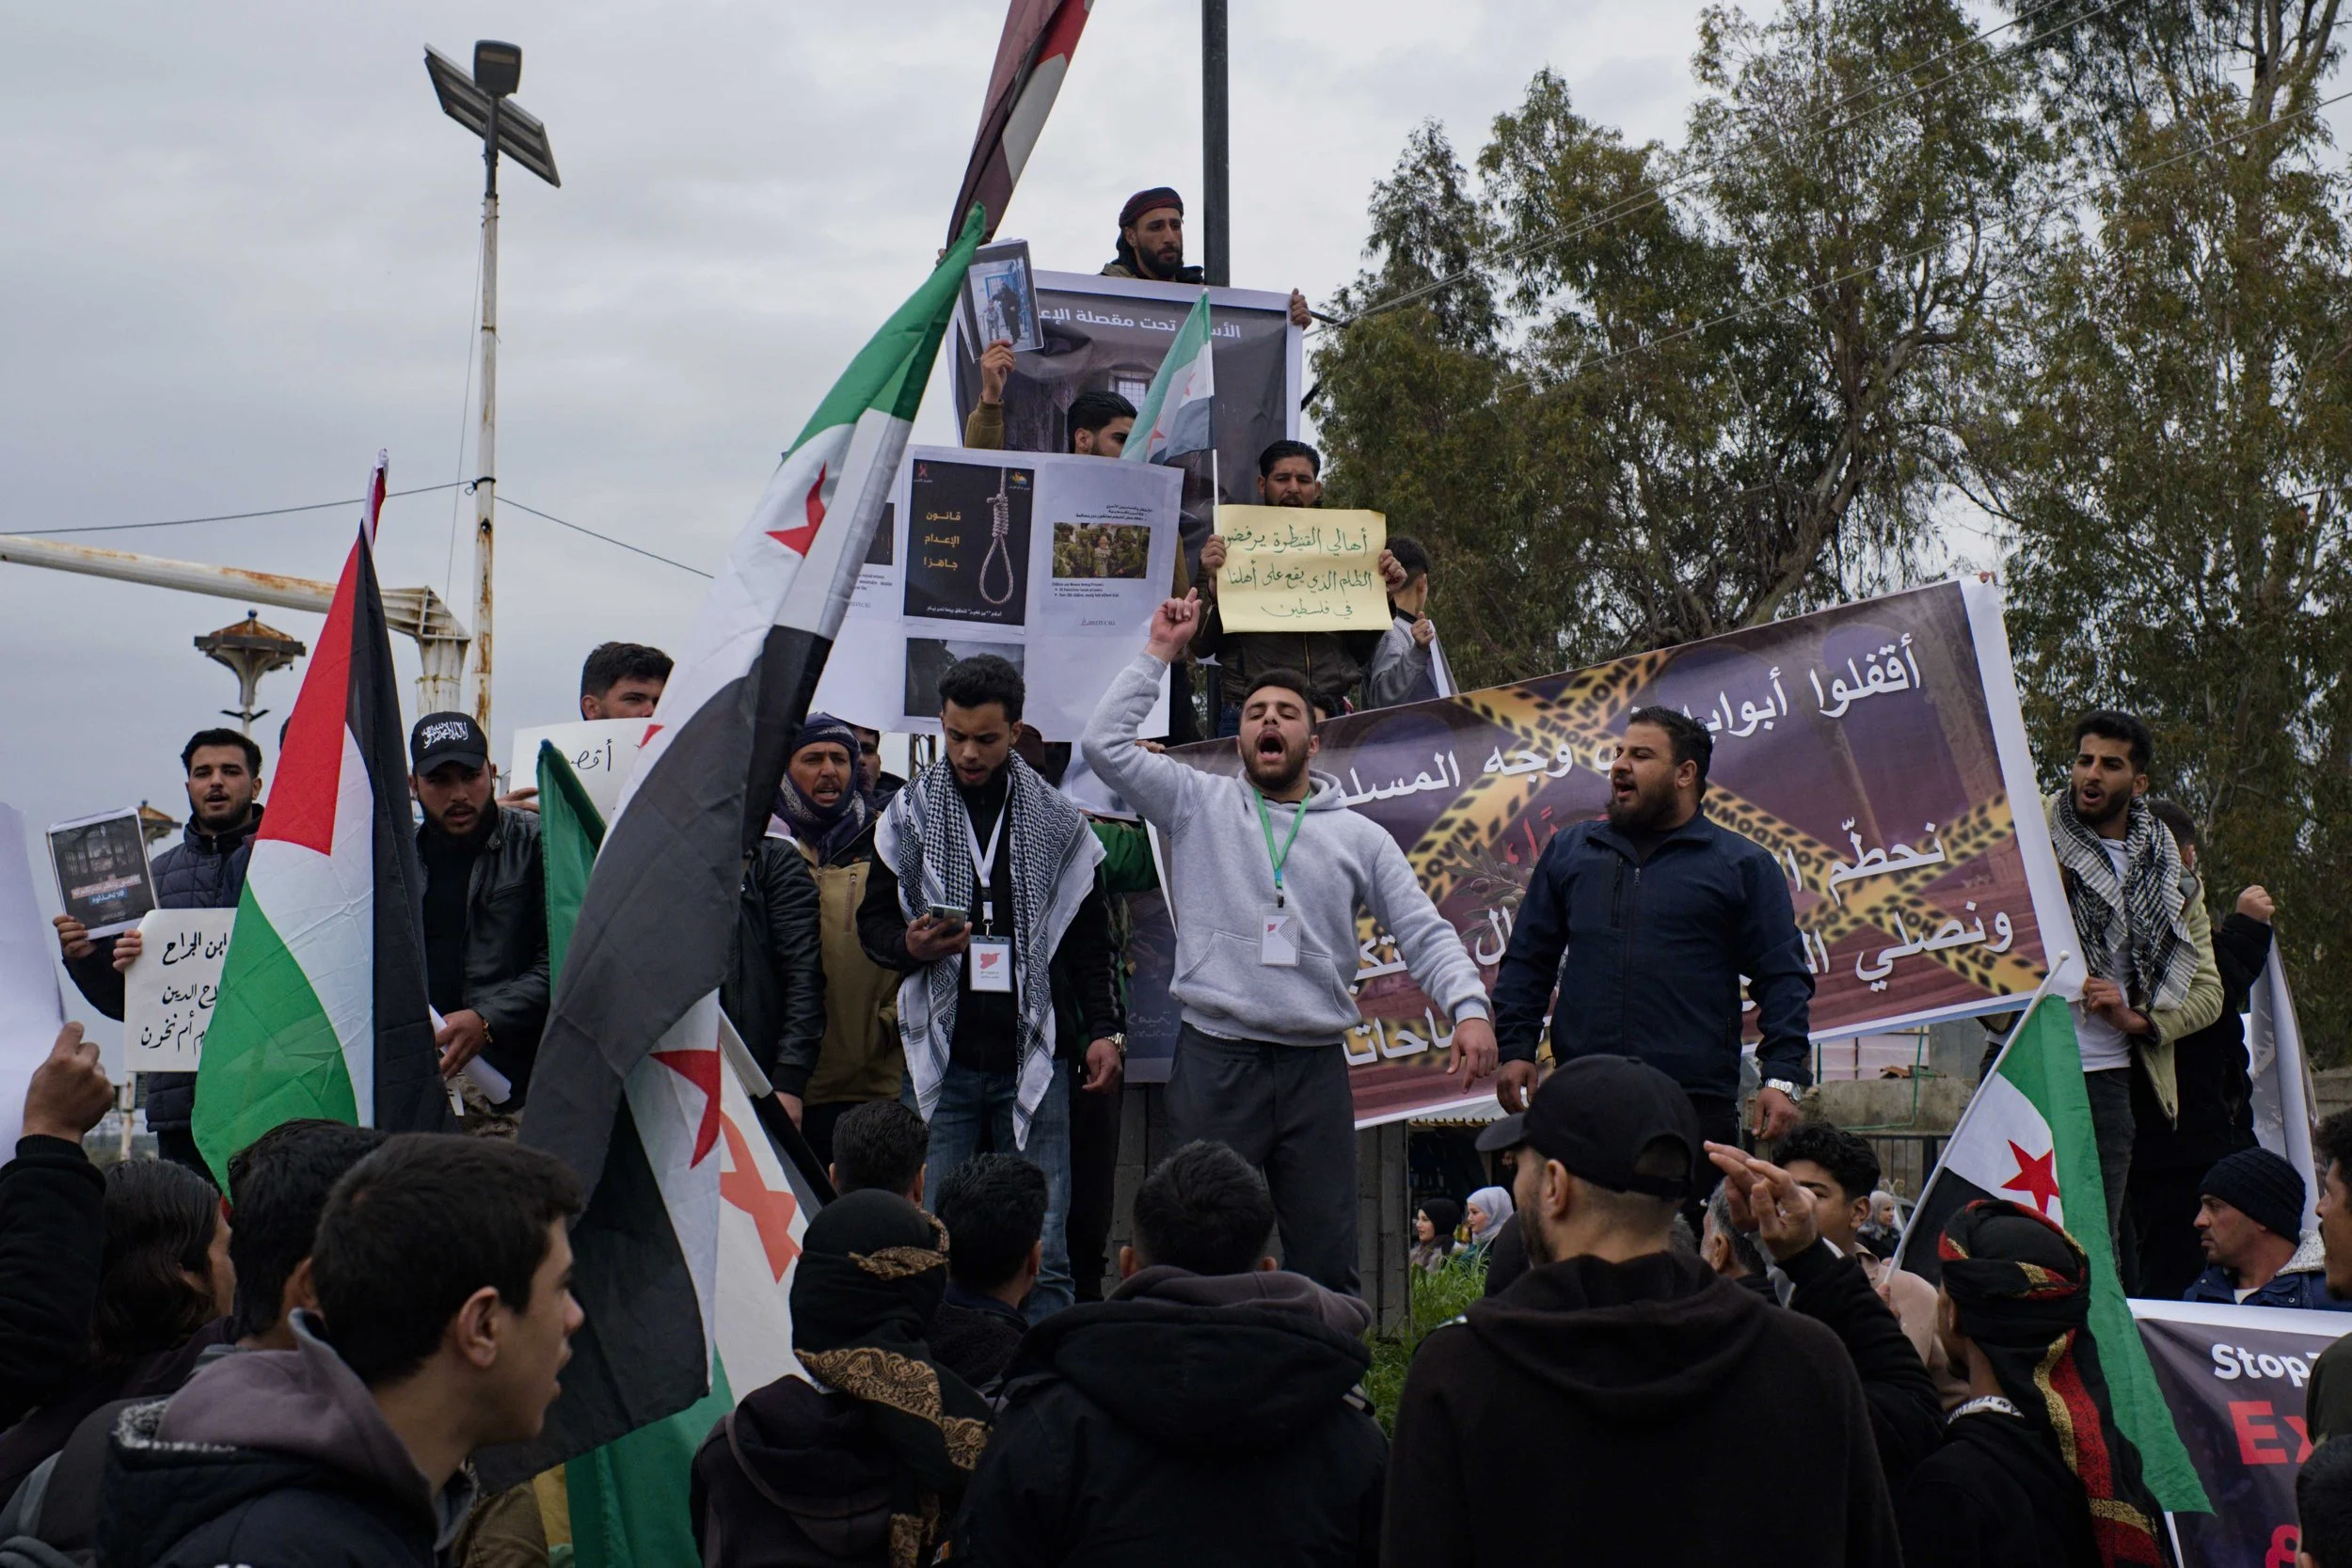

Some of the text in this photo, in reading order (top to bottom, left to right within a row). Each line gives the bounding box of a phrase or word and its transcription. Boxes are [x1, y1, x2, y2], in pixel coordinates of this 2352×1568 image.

[1039, 308, 1241, 339] الأس تحت مقصلة الإع
[1222, 524, 1368, 558] أهالي القنيطرة يرفضو
[1227, 560, 1373, 594] الظلم الذي يقع على أهلنا
[1260, 597, 1353, 620] في فلسطين
[1809, 632, 1921, 718] أقفلوا
[1682, 666, 1788, 743] أبواب
[569, 738, 613, 772] أقص
[1483, 742, 1573, 784] وجه
[1337, 750, 1460, 807] المسلم
[1829, 816, 1946, 907] نحطّم
[162, 931, 227, 966] ابن الجراح
[1855, 900, 2013, 992] ونصلي
[162, 983, 198, 1005] الدين
[177, 1010, 194, 1053] أم
[2211, 1343, 2311, 1387] Stop
